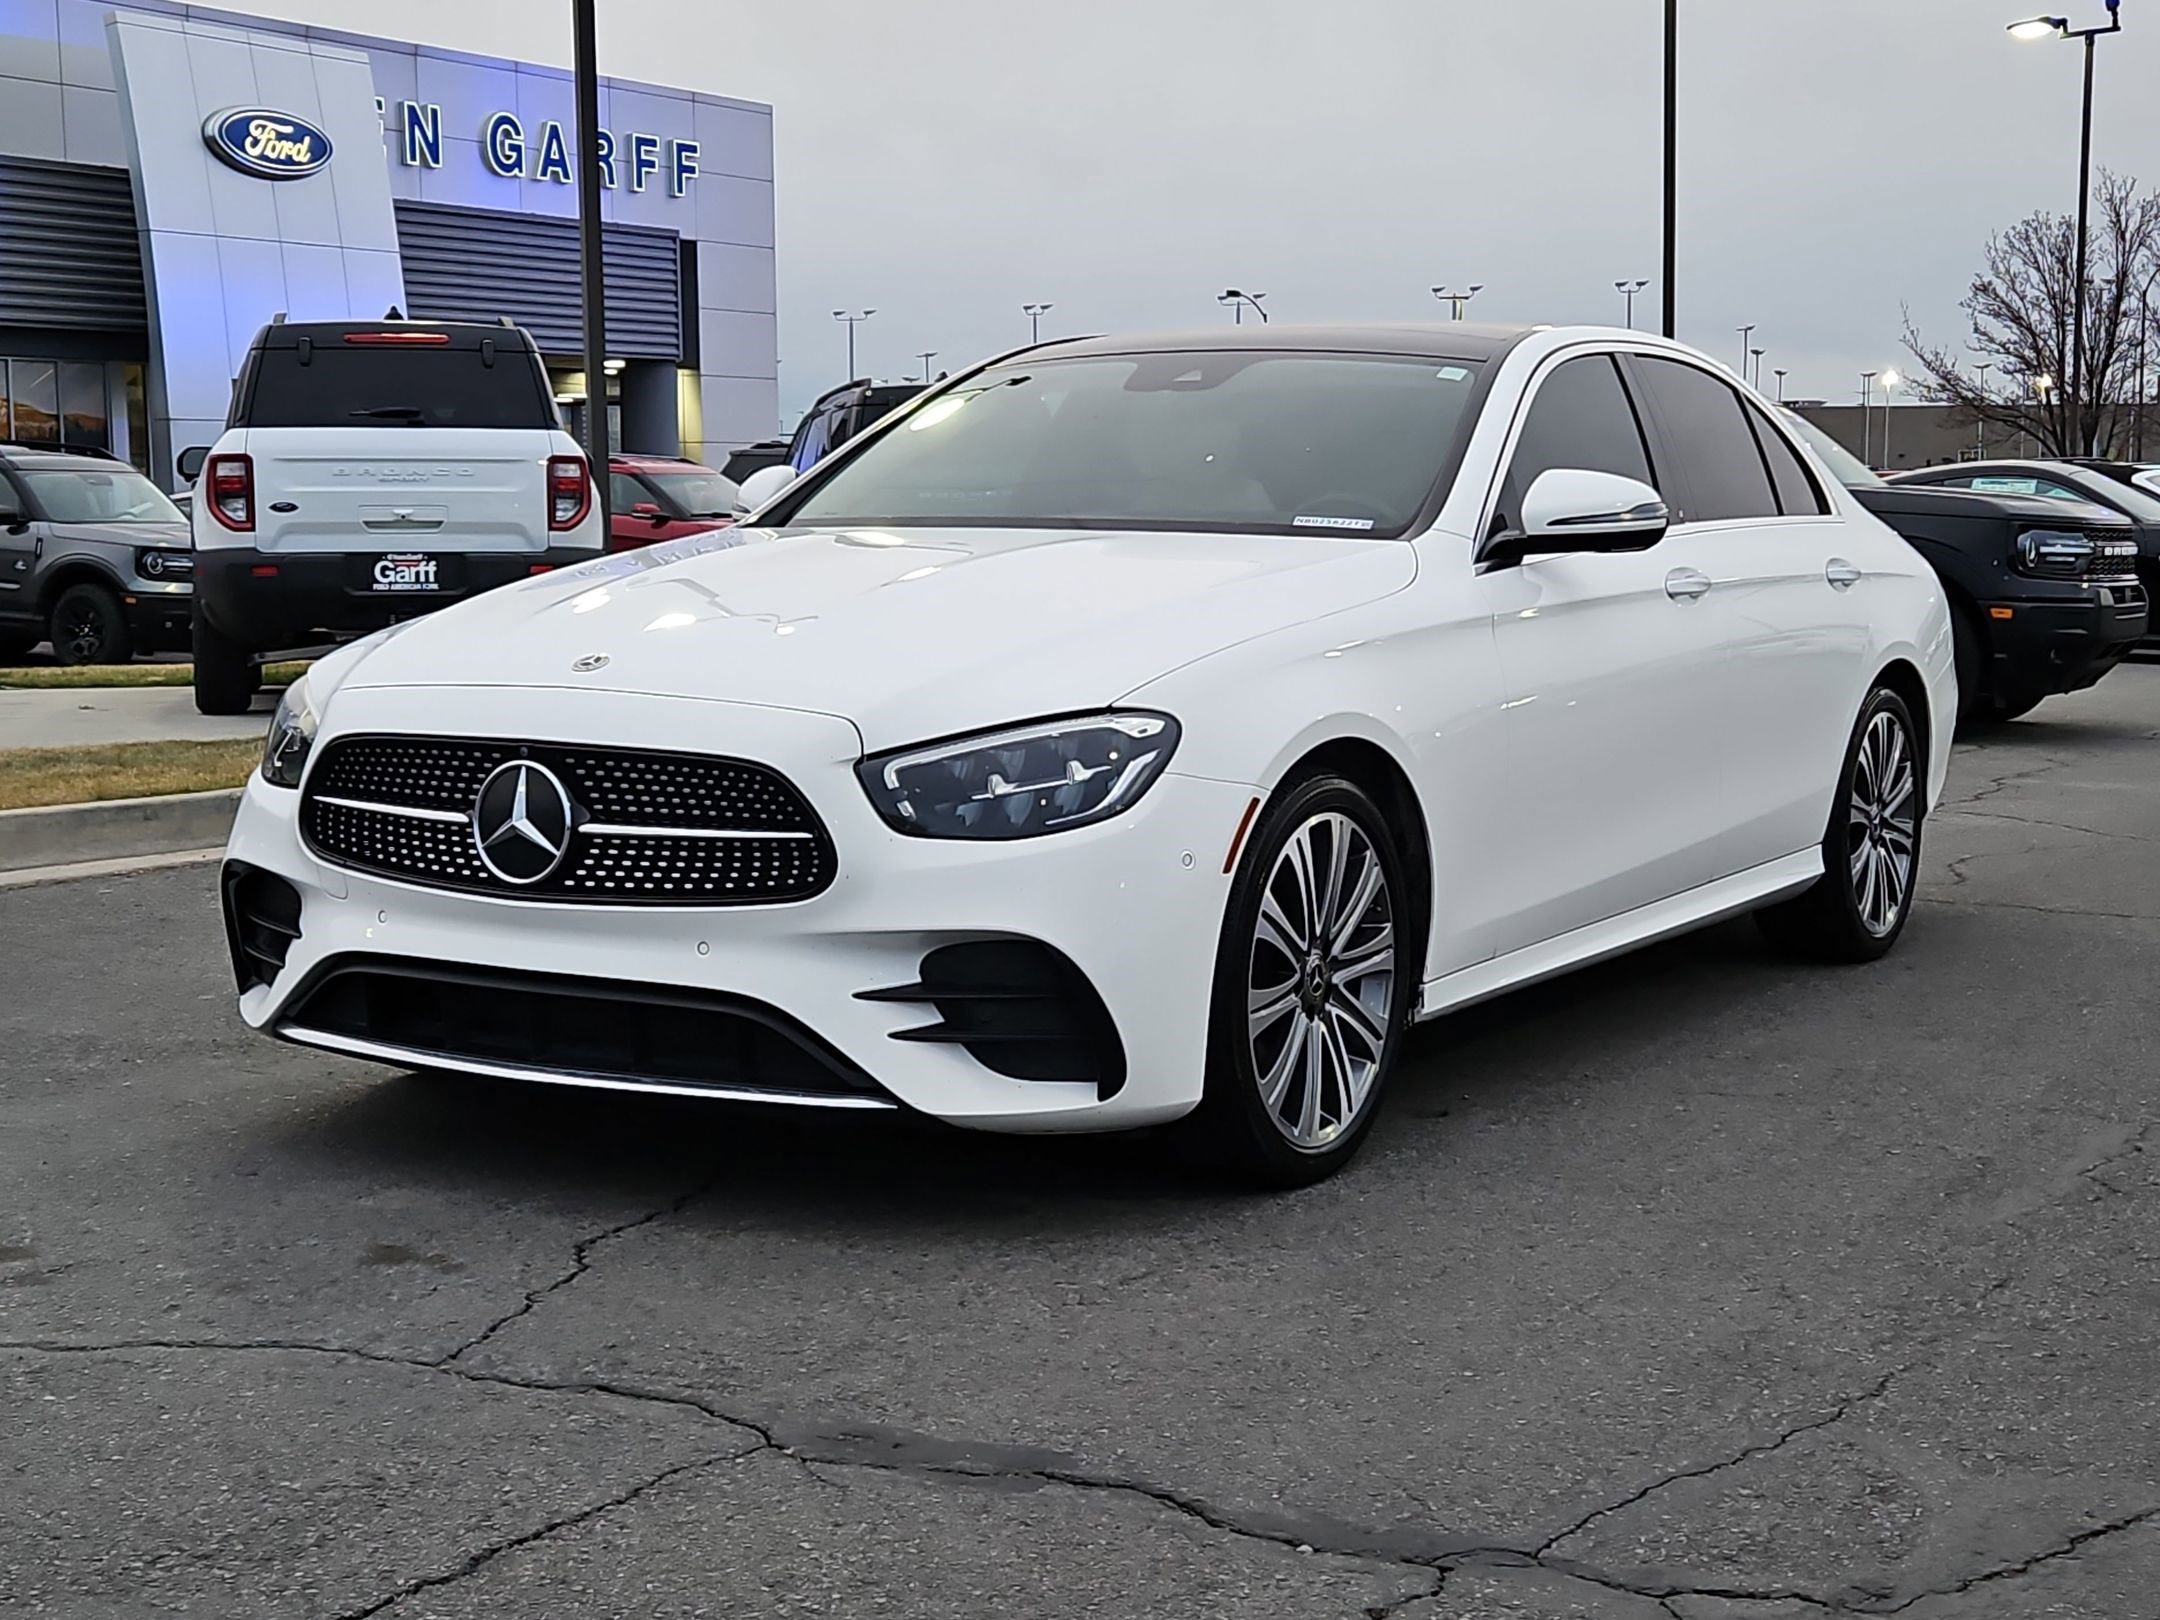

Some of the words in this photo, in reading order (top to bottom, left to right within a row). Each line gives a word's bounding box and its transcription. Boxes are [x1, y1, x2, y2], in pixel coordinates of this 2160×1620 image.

[244, 119, 312, 163] Ford
[482, 111, 701, 197] GARFF
[332, 467, 475, 477] BRONCO
[374, 560, 438, 584] Garff
